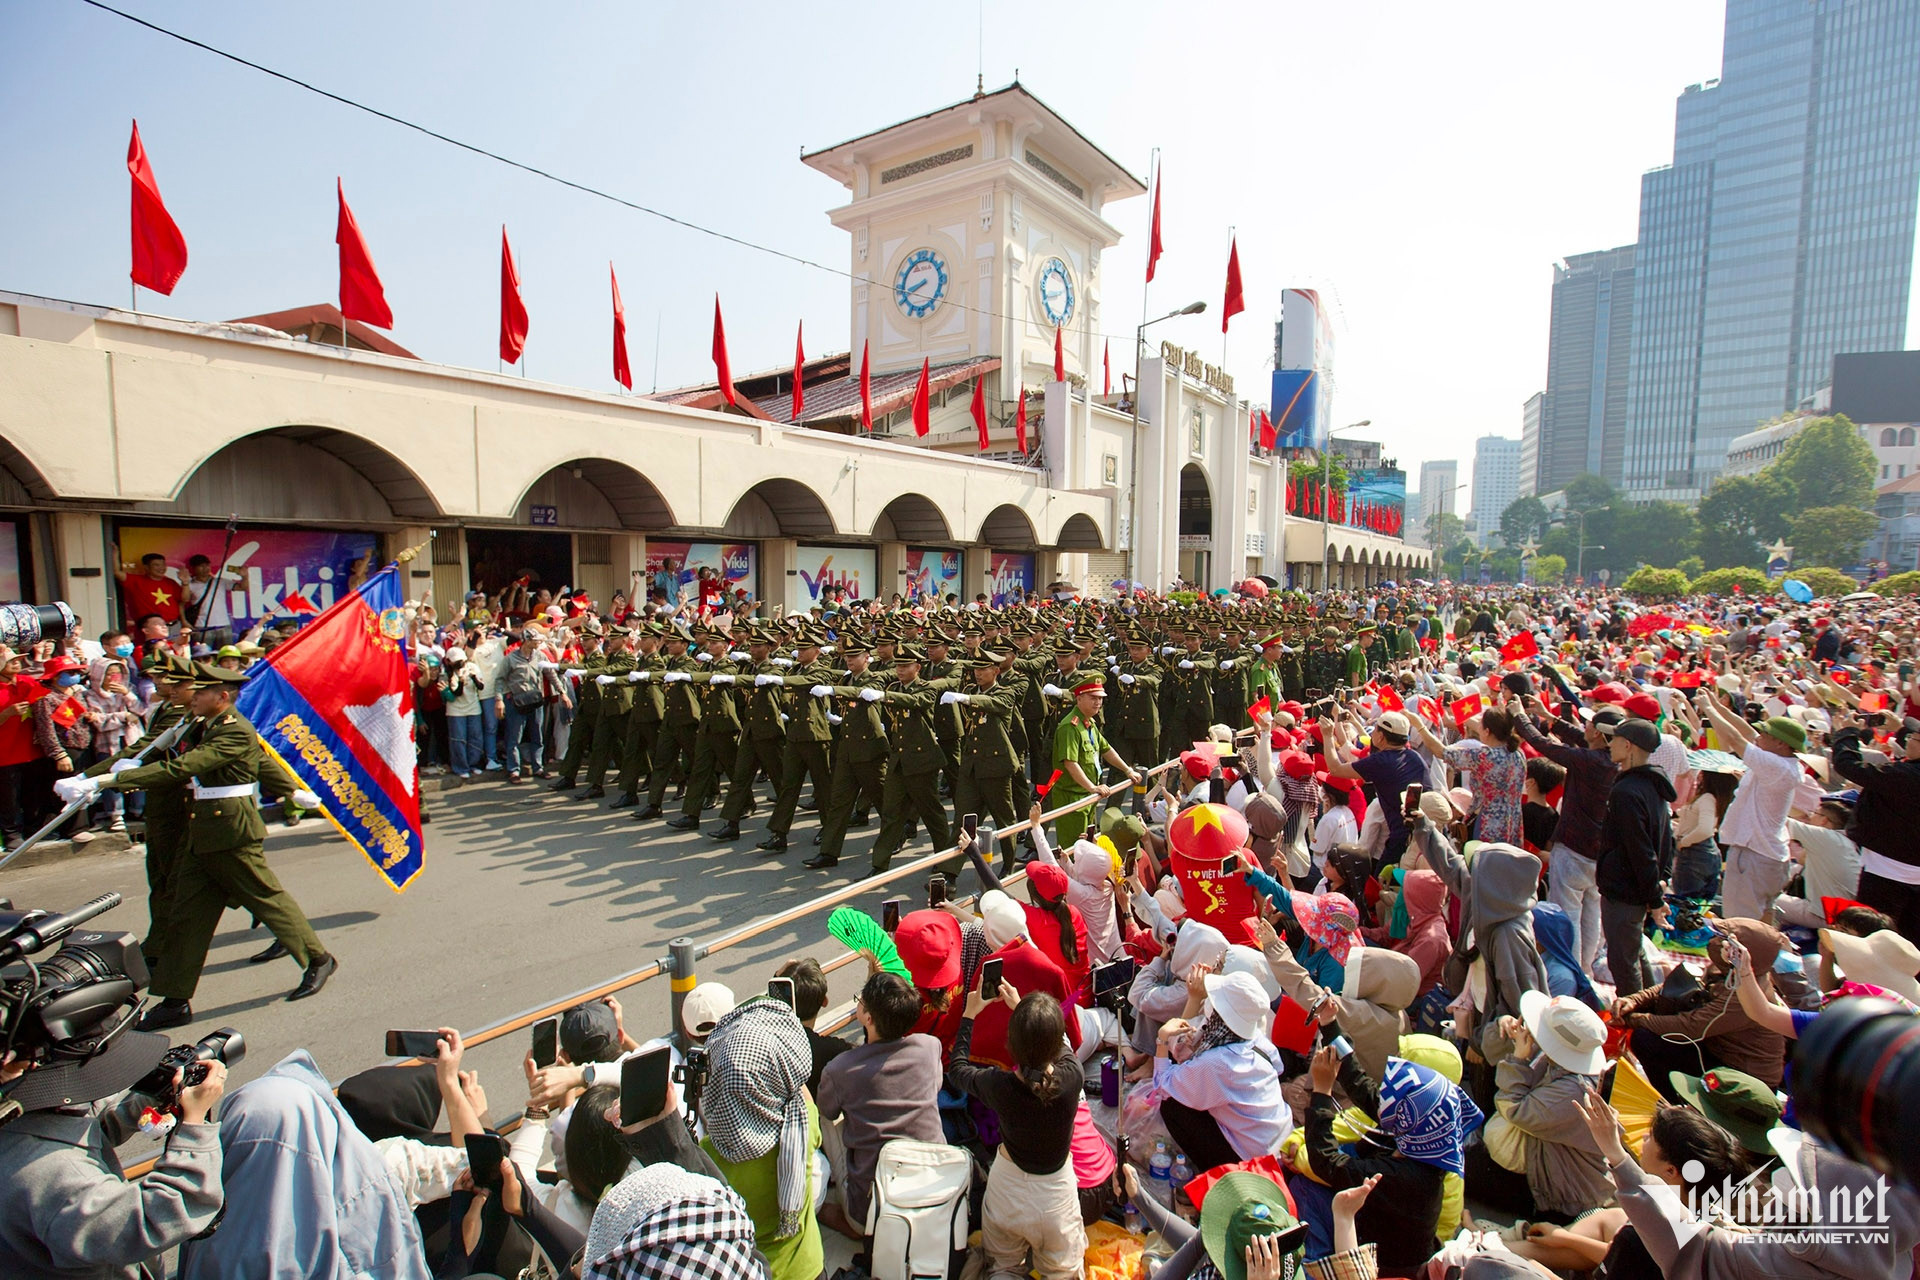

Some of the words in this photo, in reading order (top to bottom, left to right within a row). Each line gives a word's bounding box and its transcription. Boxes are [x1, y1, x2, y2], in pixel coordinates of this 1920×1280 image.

[547, 508, 556, 523] 2
[723, 551, 748, 569] Vikki
[942, 555, 958, 570] Vikki
[1187, 870, 1192, 879] I
[1201, 868, 1216, 880] VIỆT
[1411, 1140, 1445, 1152] LIMITED
